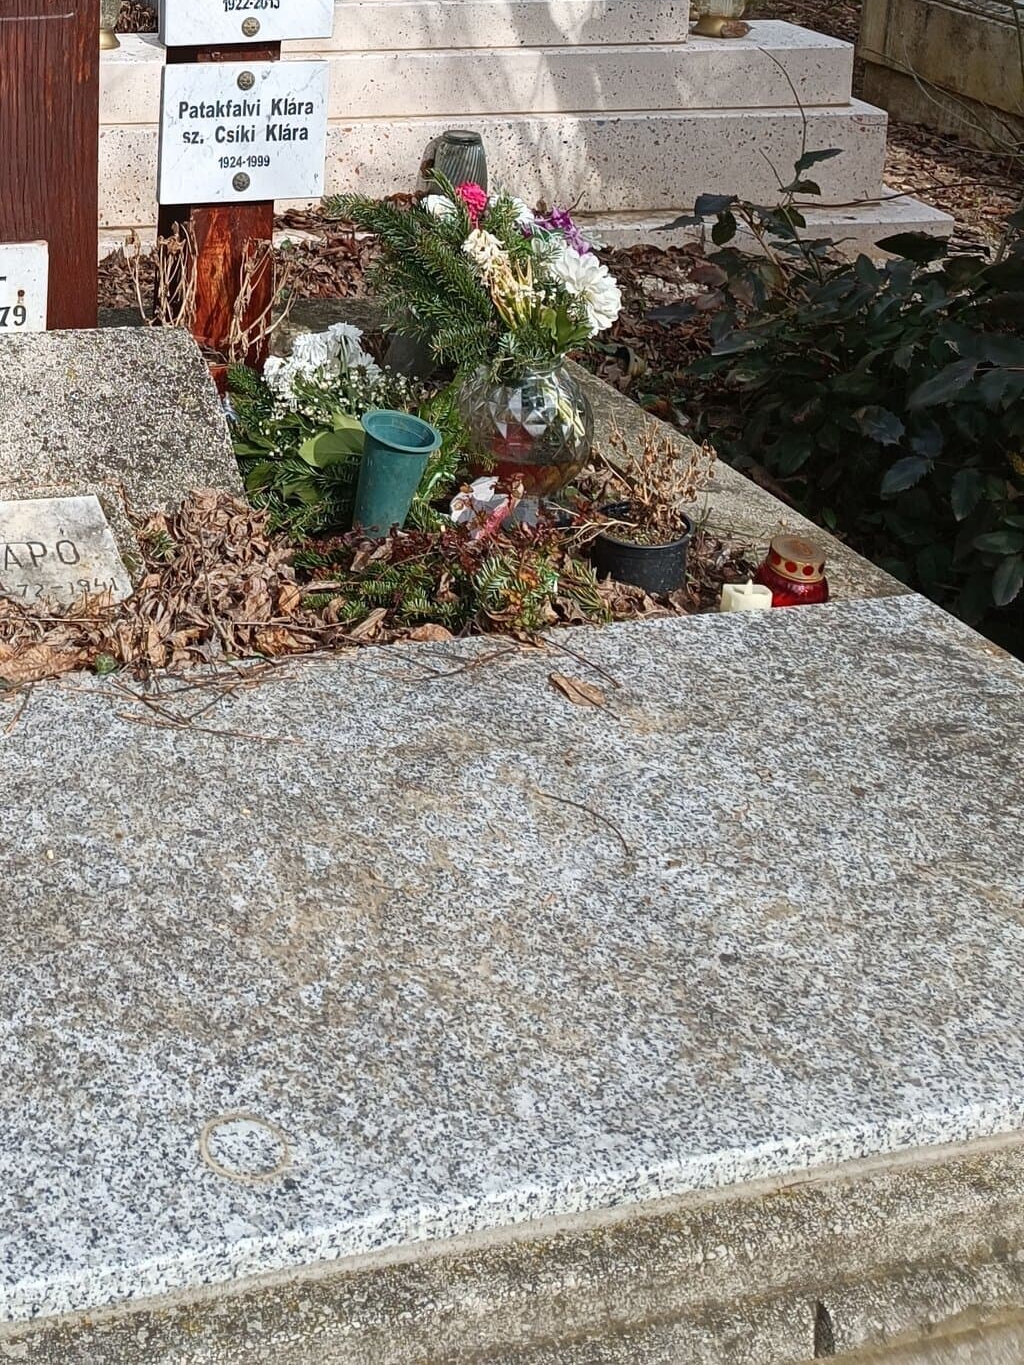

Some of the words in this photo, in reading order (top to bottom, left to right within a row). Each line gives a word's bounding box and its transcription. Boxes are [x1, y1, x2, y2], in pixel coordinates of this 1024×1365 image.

[178, 99, 261, 119] Patakfalvi
[271, 98, 314, 116] Klára
[182, 131, 204, 144] sz.
[215, 125, 255, 143] Csíki
[266, 123, 308, 142] Klára
[218, 155, 270, 169] 1924-1999
